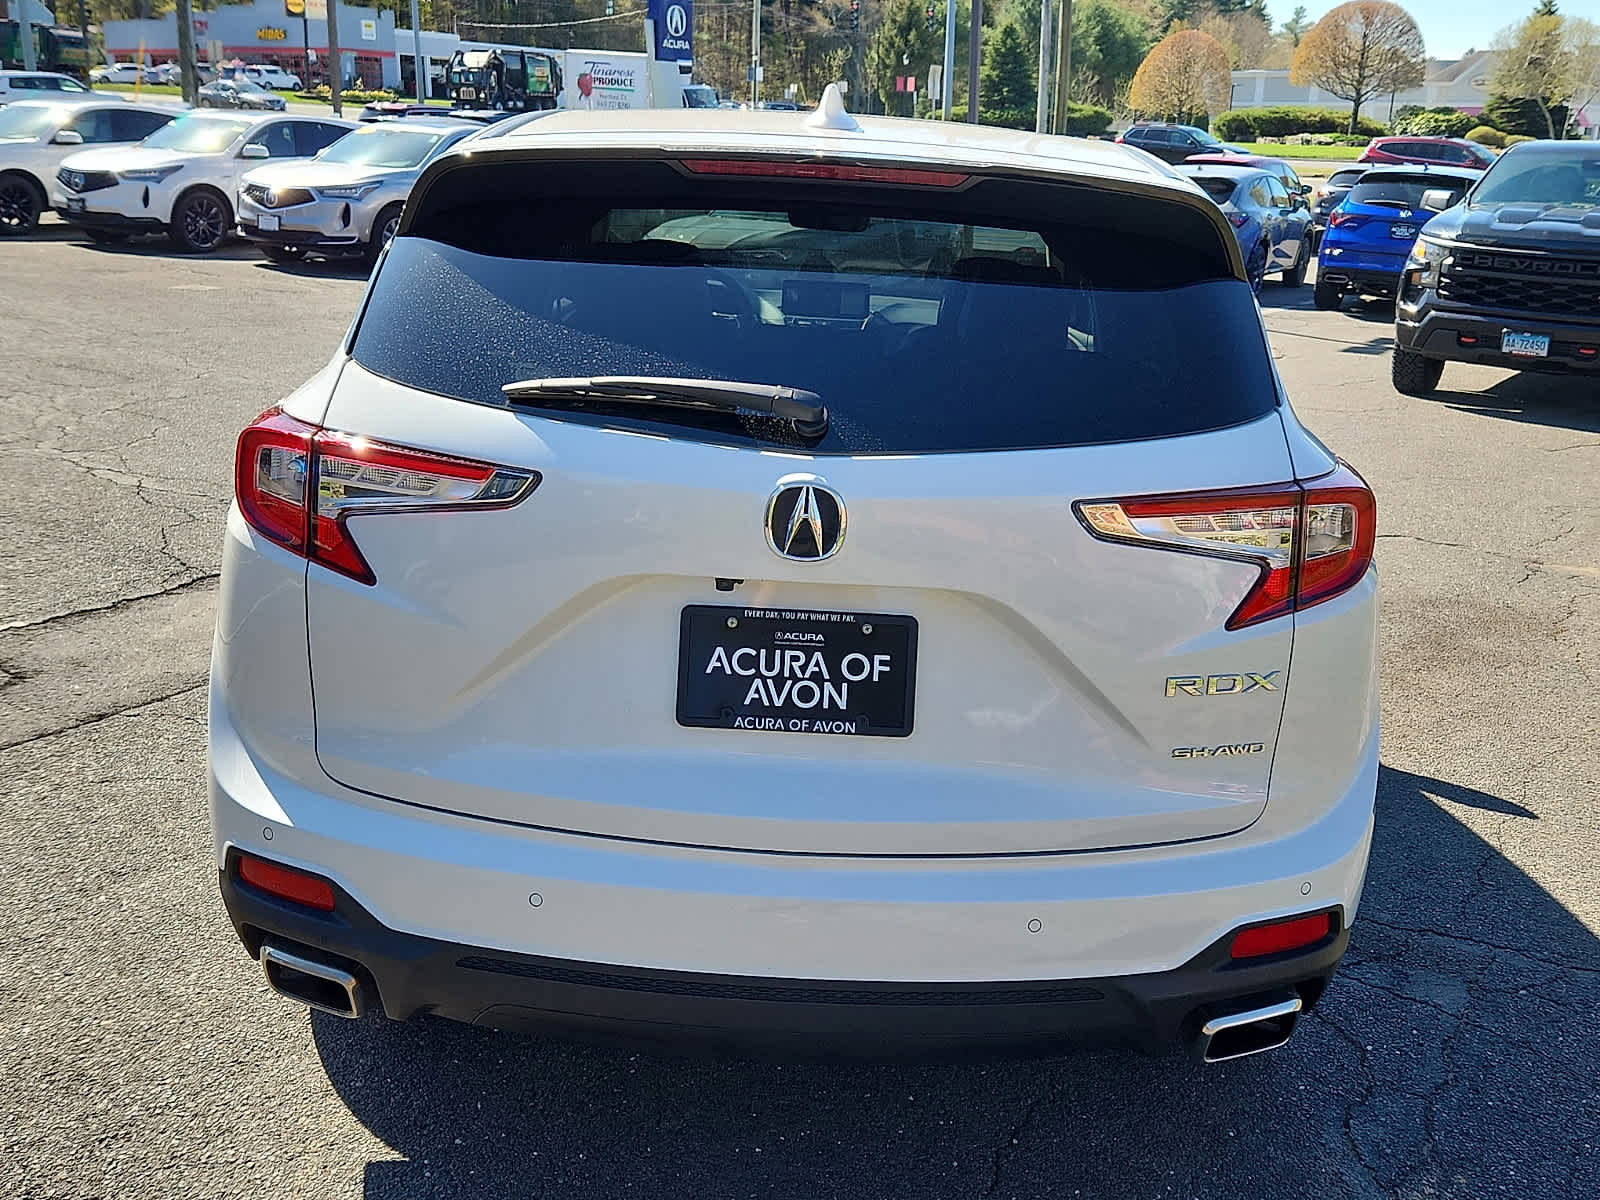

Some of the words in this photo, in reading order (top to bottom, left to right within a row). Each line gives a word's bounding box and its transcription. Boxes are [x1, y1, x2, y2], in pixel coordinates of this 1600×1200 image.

[662, 39, 690, 50] ACURA
[593, 77, 634, 87] PRODUCE
[744, 609, 764, 618] EVERY
[765, 610, 780, 619] DAY,
[782, 611, 796, 619] YOU
[797, 612, 809, 620] PAY
[810, 612, 829, 621] WHAT
[842, 614, 856, 622] PAY.
[784, 632, 825, 641] ACURA
[705, 647, 830, 680] ACURA
[841, 653, 891, 682] OF
[1165, 671, 1281, 697] RDX
[743, 678, 848, 710] AVON
[734, 716, 785, 731] ACURA
[789, 719, 810, 731] OF
[813, 720, 856, 734] AVON
